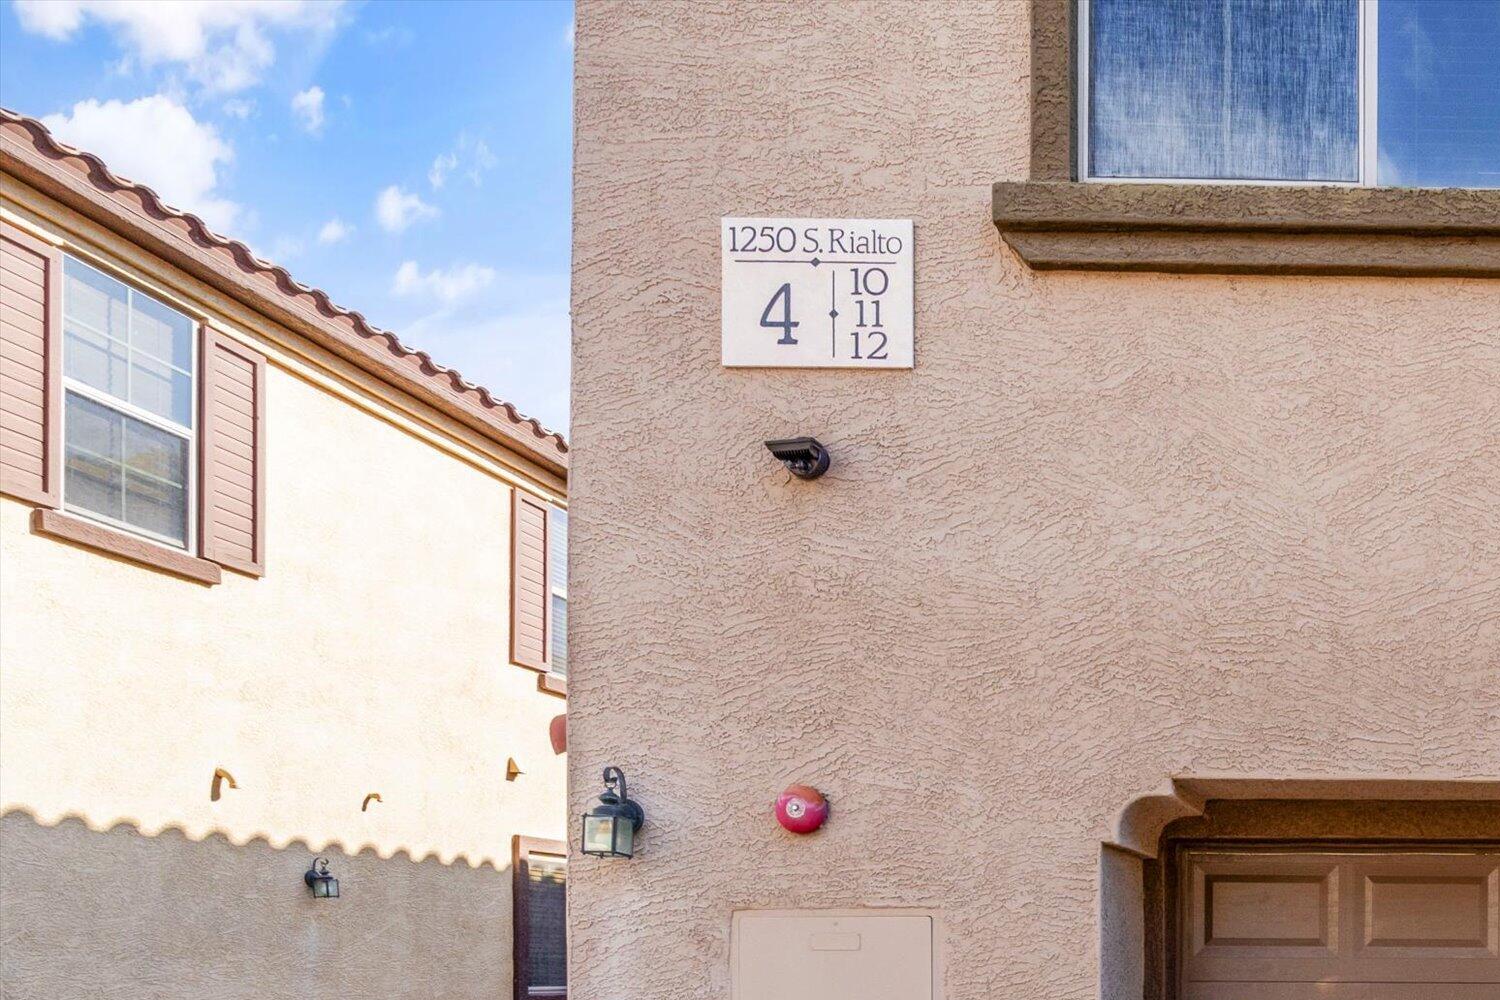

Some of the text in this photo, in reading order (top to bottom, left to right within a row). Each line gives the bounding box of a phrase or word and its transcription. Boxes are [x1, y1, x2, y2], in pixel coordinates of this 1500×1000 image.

[729, 227, 903, 254] 1250 S. Rialto
[850, 267, 889, 296] 10
[760, 283, 800, 345] 4
[855, 300, 883, 328] 11
[850, 331, 888, 360] 12
